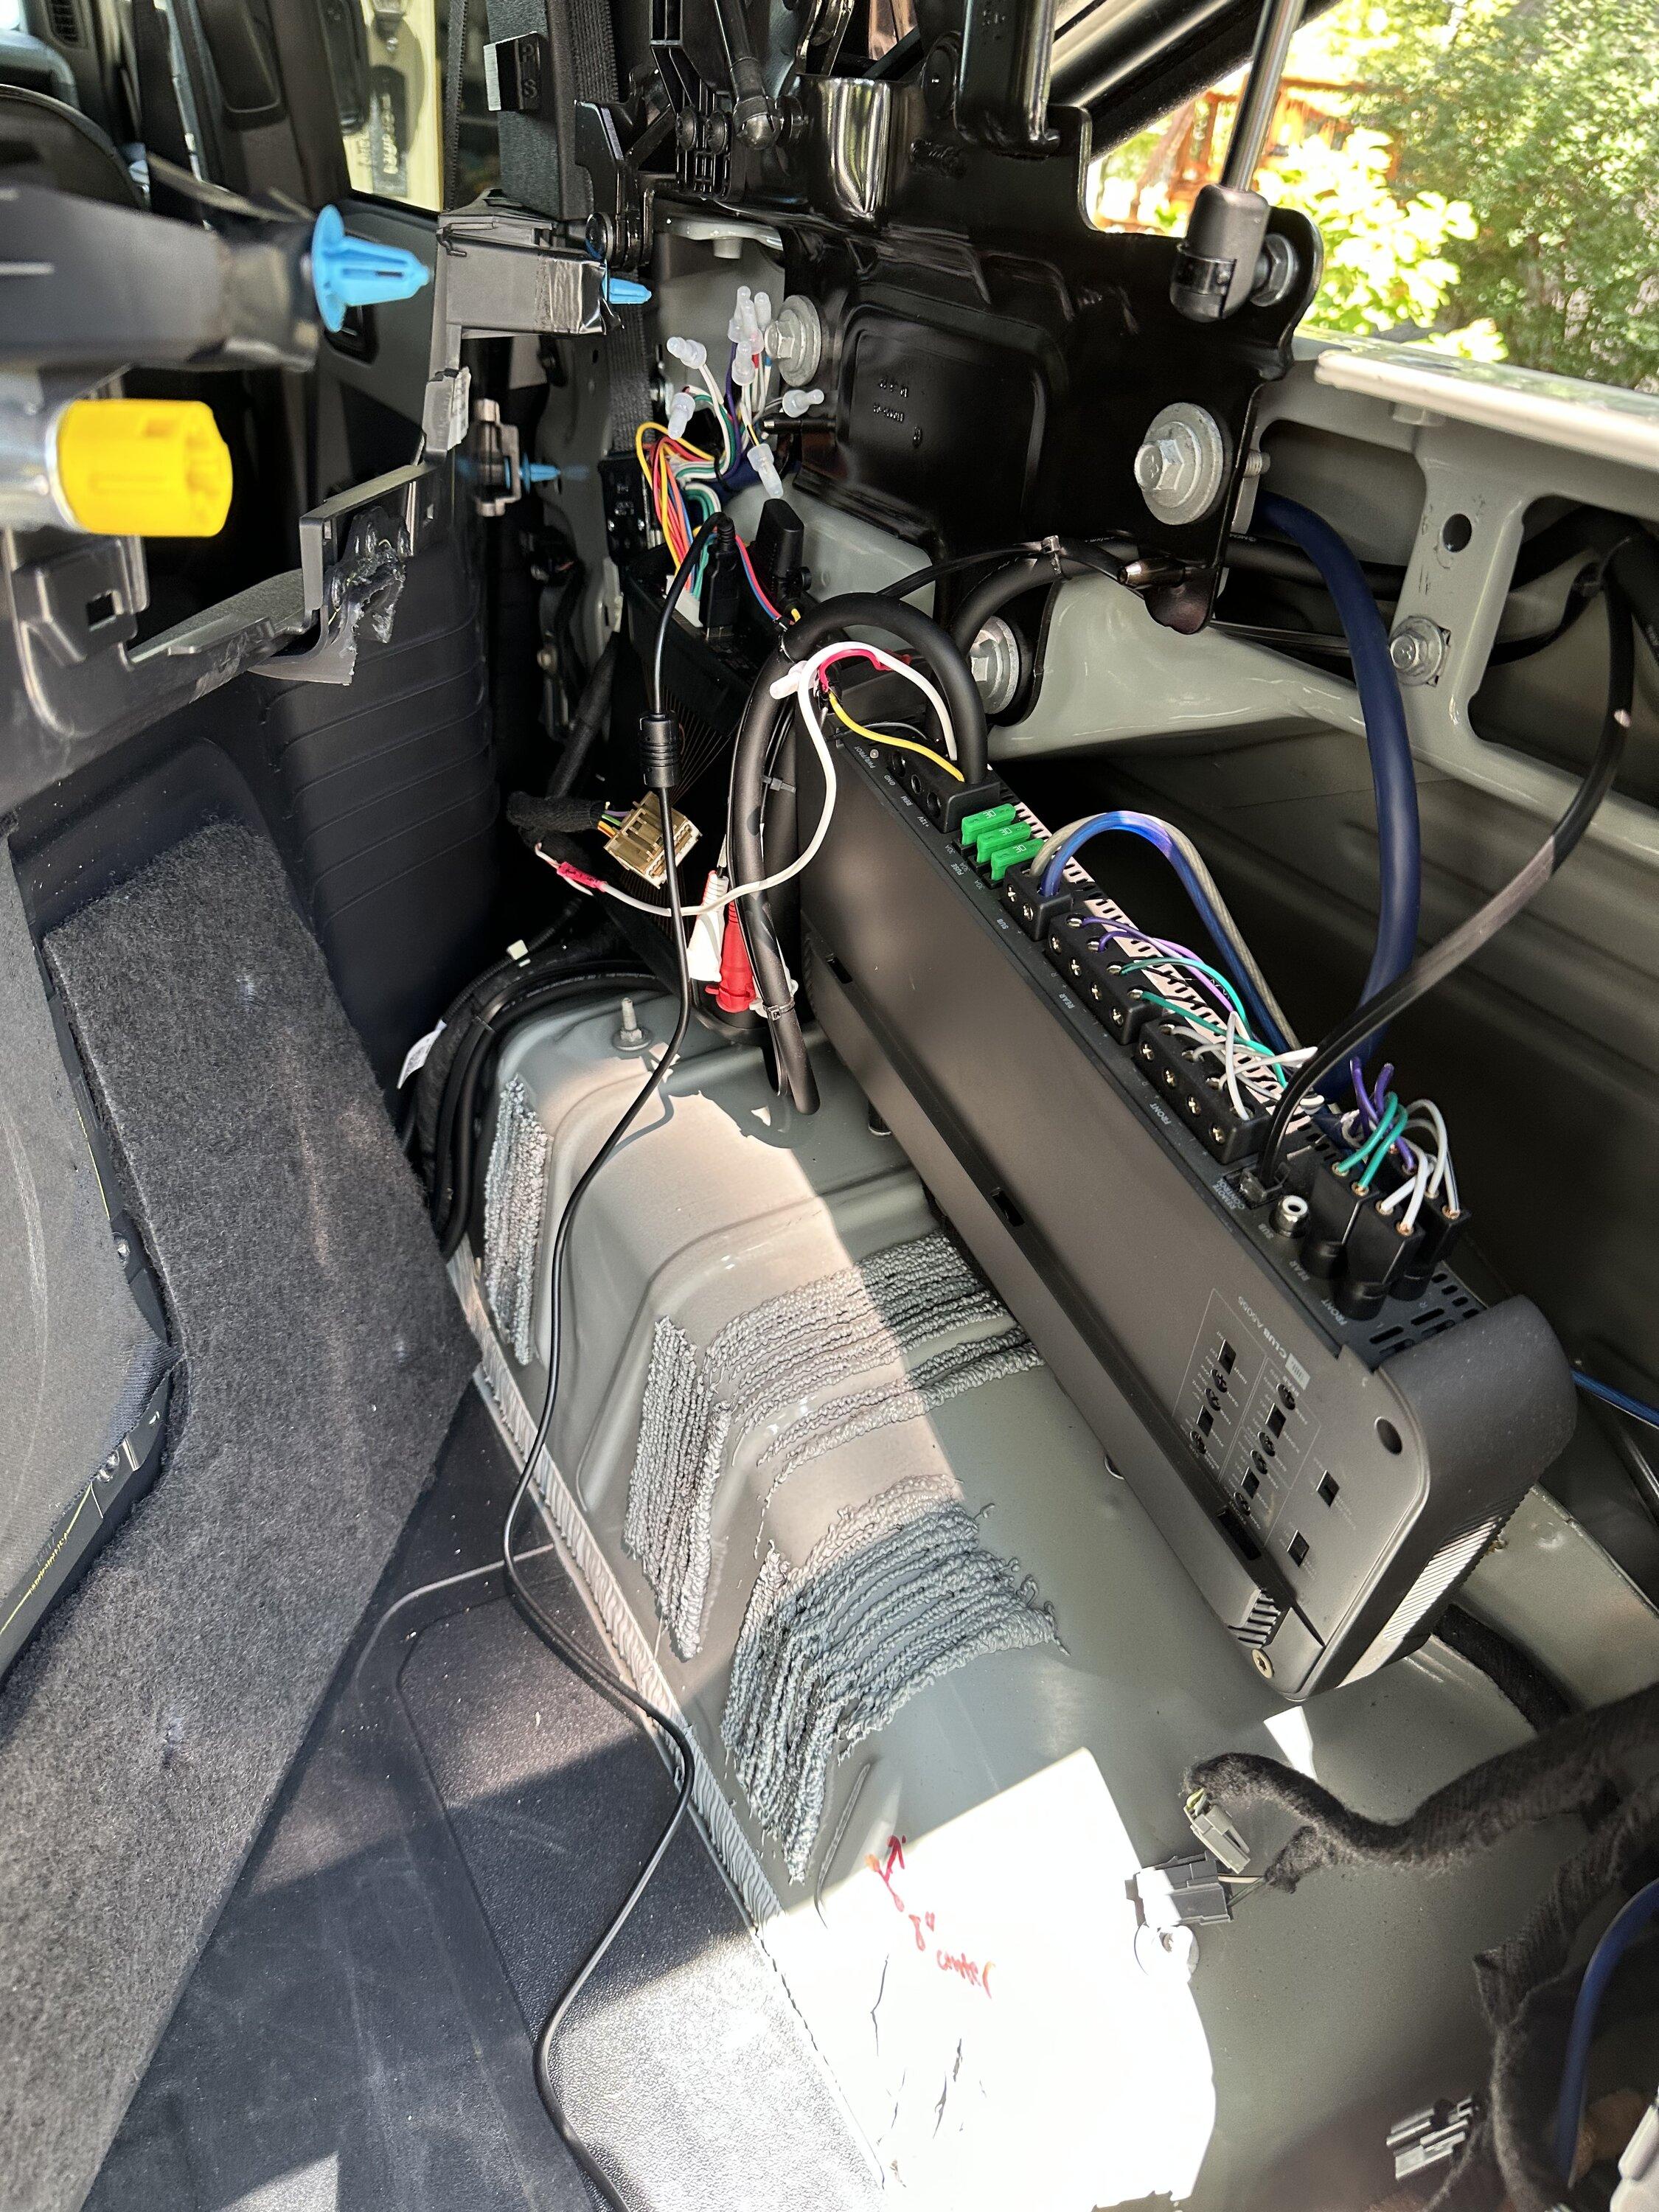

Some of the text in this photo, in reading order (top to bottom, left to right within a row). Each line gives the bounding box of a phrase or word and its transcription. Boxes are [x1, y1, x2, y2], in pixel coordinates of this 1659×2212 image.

[884, 775, 896, 786] GND
[900, 796, 914, 807] REM
[983, 810, 996, 819] 30
[998, 827, 1012, 836] 30
[1012, 844, 1027, 853] 30
[950, 863, 964, 876] FUSE
[996, 918, 1009, 930] SUB
[1059, 993, 1076, 1009] REAR
[1149, 1103, 1172, 1125] FRONT
[1258, 1223, 1274, 1239] SUB
[1289, 1261, 1310, 1281] REAR
[1321, 1299, 1348, 1326] FRONT
[1264, 1327, 1287, 1358] CLUB
